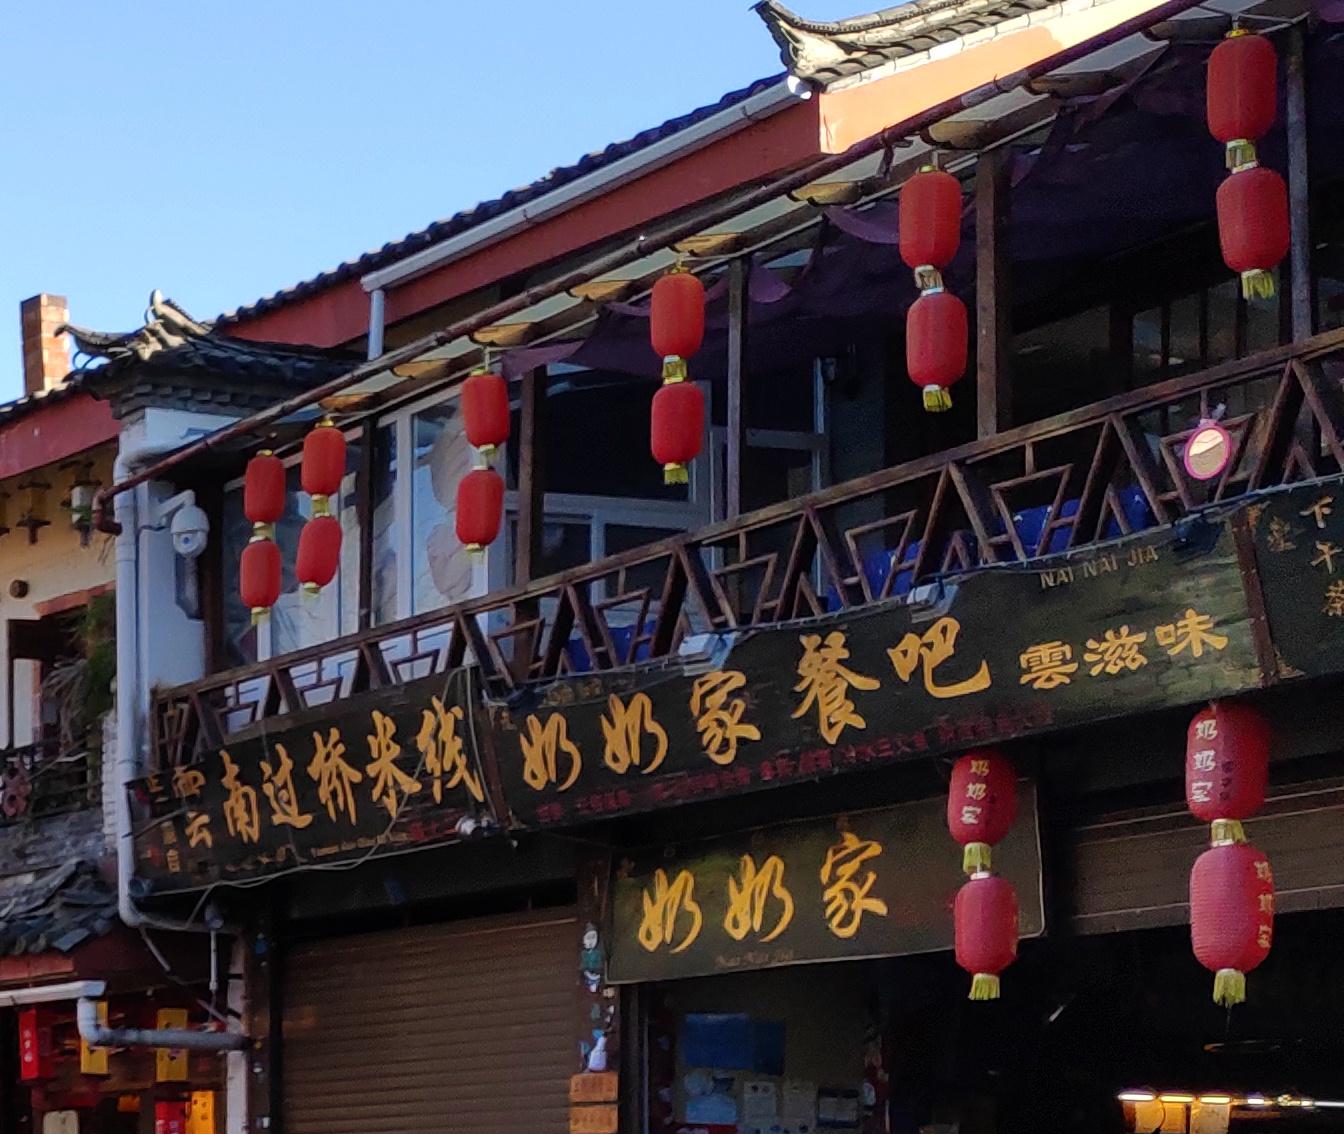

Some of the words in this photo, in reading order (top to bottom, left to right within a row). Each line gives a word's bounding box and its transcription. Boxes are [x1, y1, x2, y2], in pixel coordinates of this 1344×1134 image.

[1039, 567, 1075, 590] NAI
[1083, 553, 1120, 579] NAI
[1126, 544, 1160, 568] JIA
[518, 616, 993, 793] 奶奶家餐吧
[637, 830, 892, 955] 奶奶家
